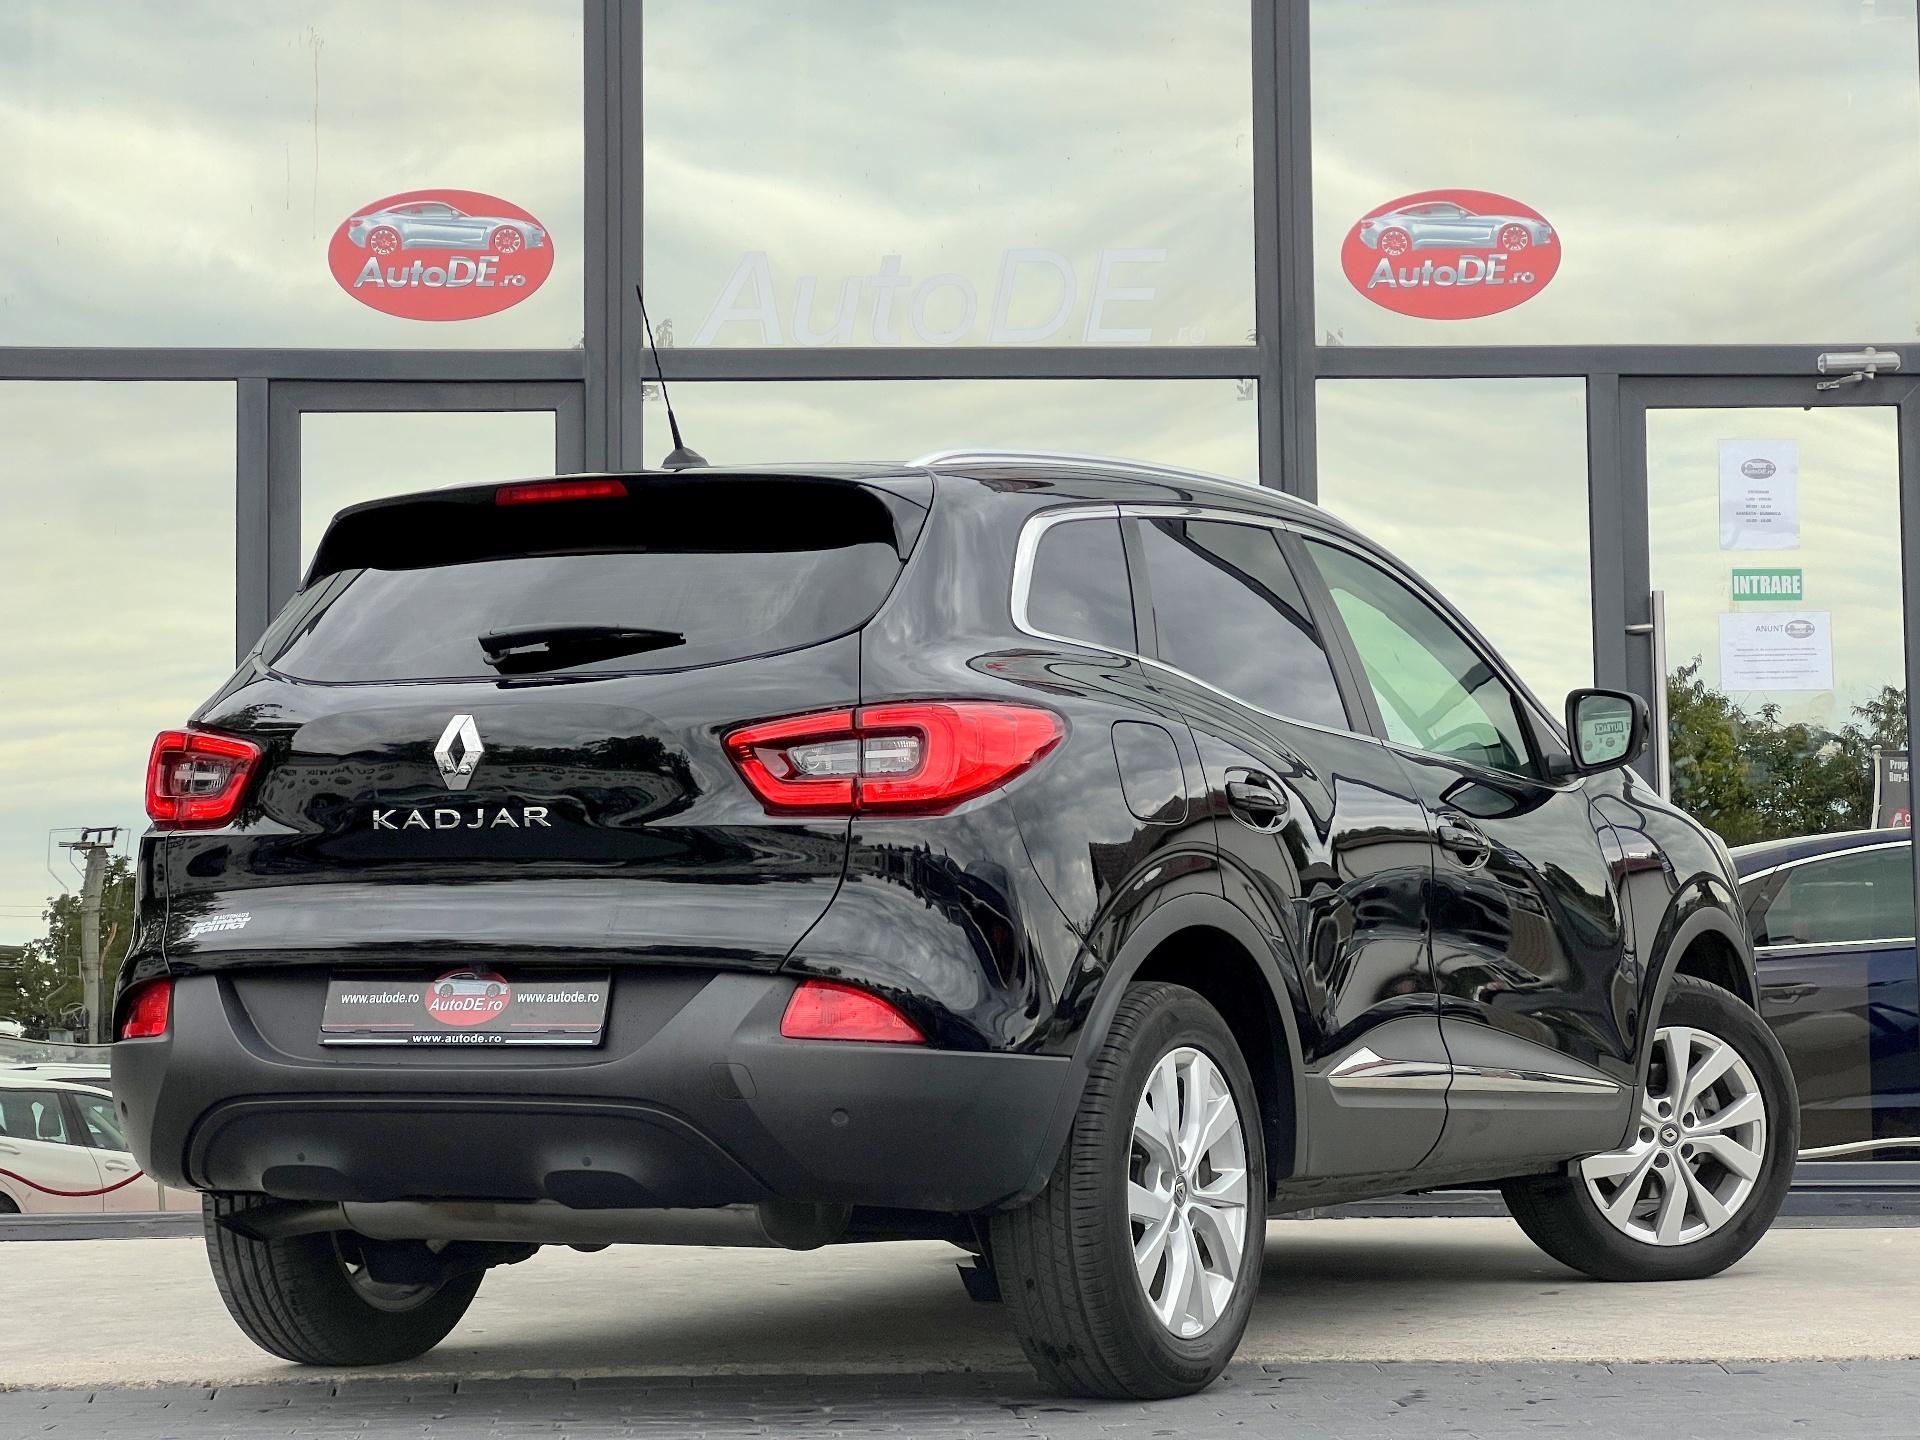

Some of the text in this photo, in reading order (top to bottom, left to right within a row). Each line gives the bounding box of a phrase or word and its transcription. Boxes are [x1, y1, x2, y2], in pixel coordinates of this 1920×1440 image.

[1733, 575, 1801, 594] INTRARE
[372, 807, 552, 830] KADJAR
[341, 991, 420, 1005] www.autode.ro
[517, 990, 600, 1004] www.autode.ro
[428, 997, 504, 1012] AutoDE.ro
[412, 1033, 502, 1044] www.autode.ro
